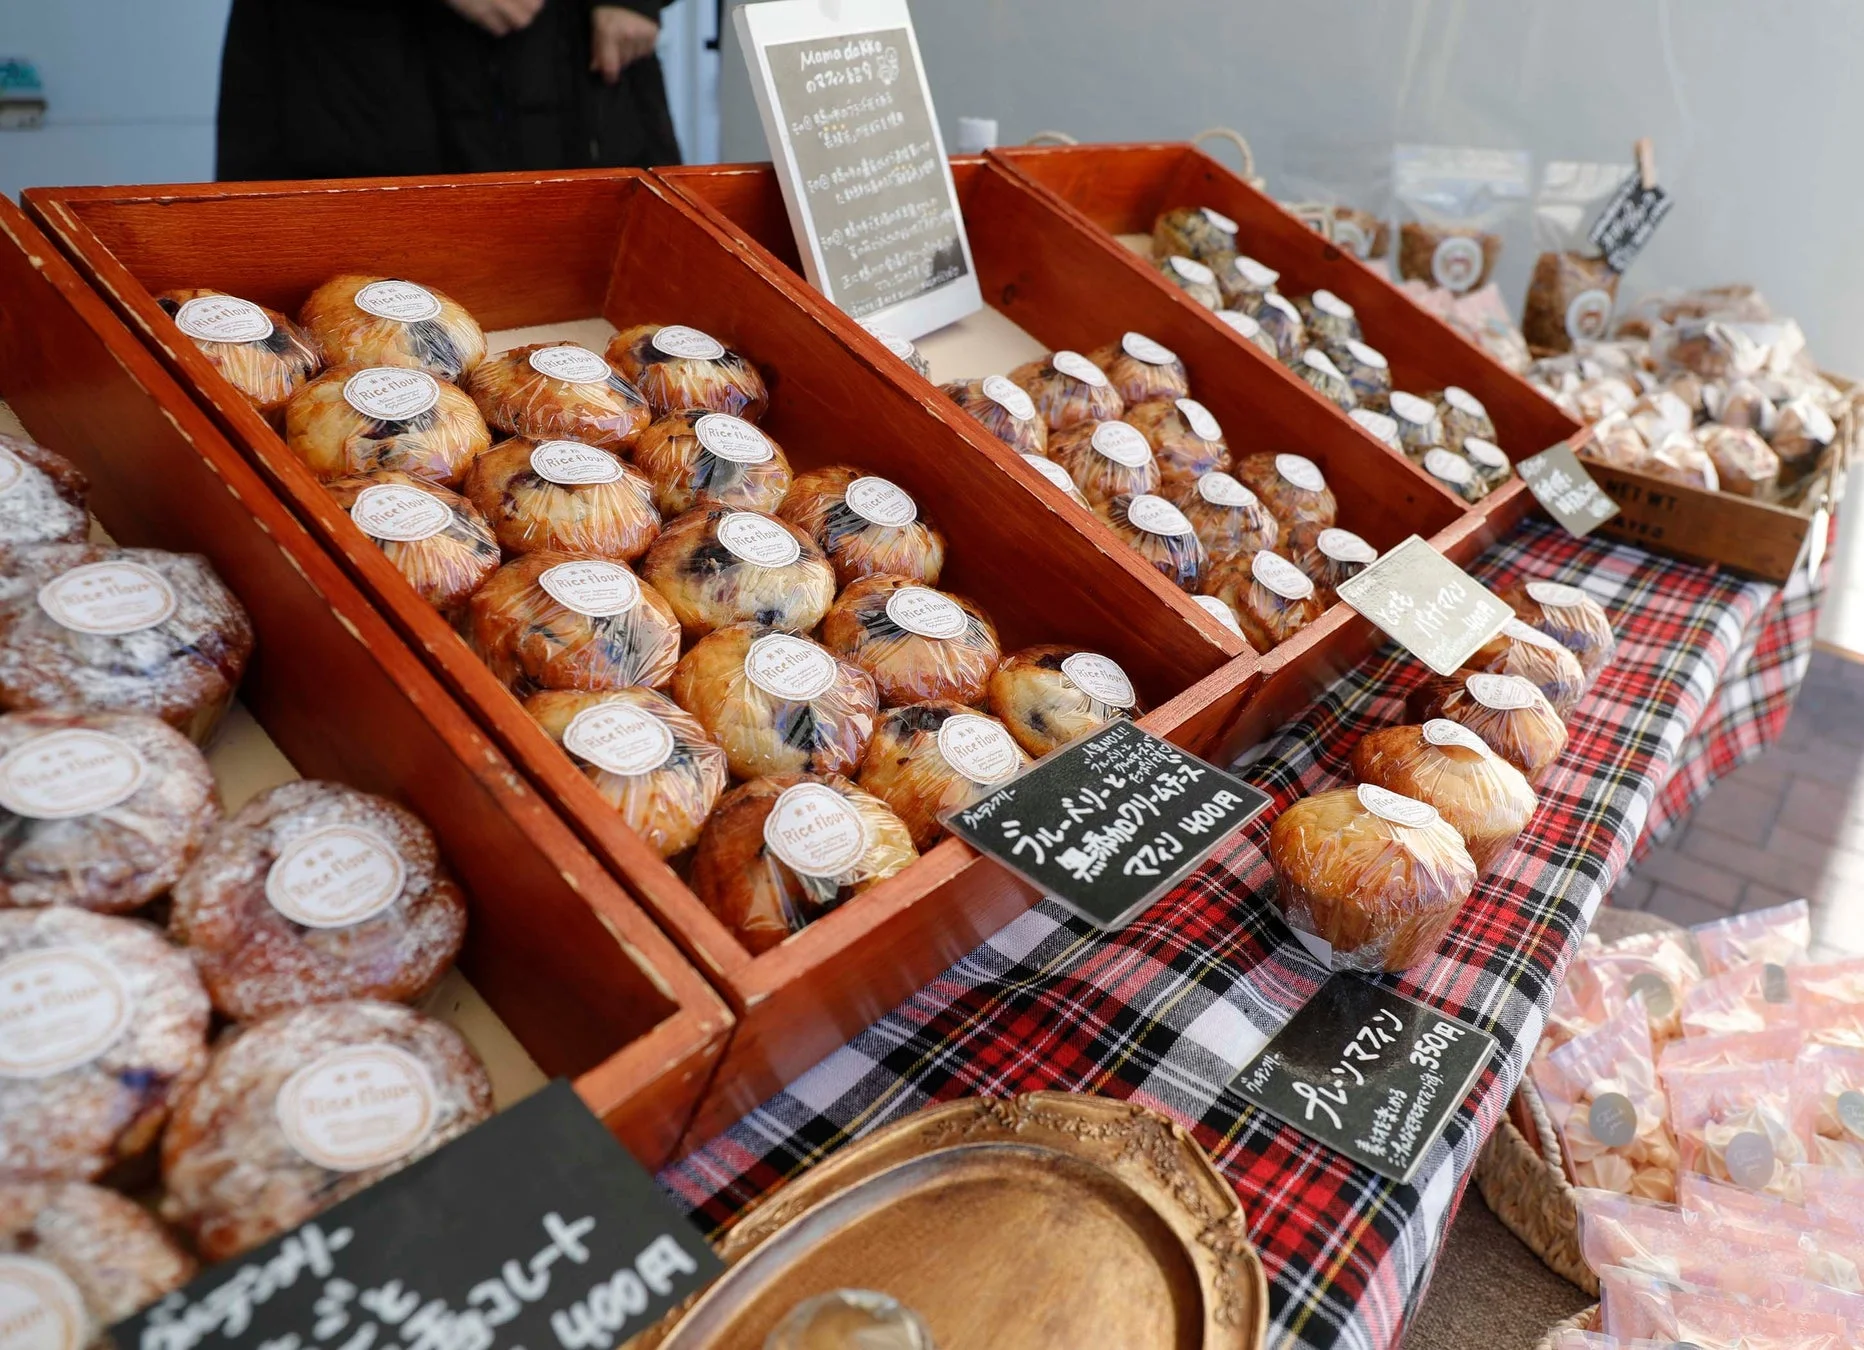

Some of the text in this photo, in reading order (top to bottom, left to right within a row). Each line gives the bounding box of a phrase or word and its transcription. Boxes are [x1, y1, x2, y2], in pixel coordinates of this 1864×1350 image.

[801, 50, 841, 71] Mama
[370, 291, 422, 307] Rice flour
[194, 315, 221, 329] Rice
[222, 307, 251, 321] flour
[543, 354, 592, 369] Rice flour
[359, 386, 389, 401] Rice
[389, 377, 418, 393] flour
[707, 427, 760, 443] Rice flour
[546, 457, 575, 469] Rice
[576, 453, 605, 464] flour
[861, 496, 879, 512] Rice
[877, 487, 897, 505] flour
[368, 509, 397, 525] Rice
[397, 499, 426, 516] flour
[731, 530, 780, 547] Rice flour
[556, 572, 620, 589] Rice flour
[902, 601, 949, 620] Rice flour
[762, 661, 786, 681] Rice
[784, 647, 813, 670] flour
[1074, 669, 1099, 680] Rice
[584, 732, 614, 750] Rice
[614, 719, 646, 738] flour
[953, 731, 1001, 759] Rice flour
[781, 811, 846, 844] Rice flour
[1001, 773, 1126, 865] ブルーベリーと
[1123, 789, 1243, 876] マフィン 400円
[1409, 1020, 1466, 1071] 350円
[1291, 1007, 1404, 1131] プレーンマフィン
[549, 1233, 699, 1350] 400円
